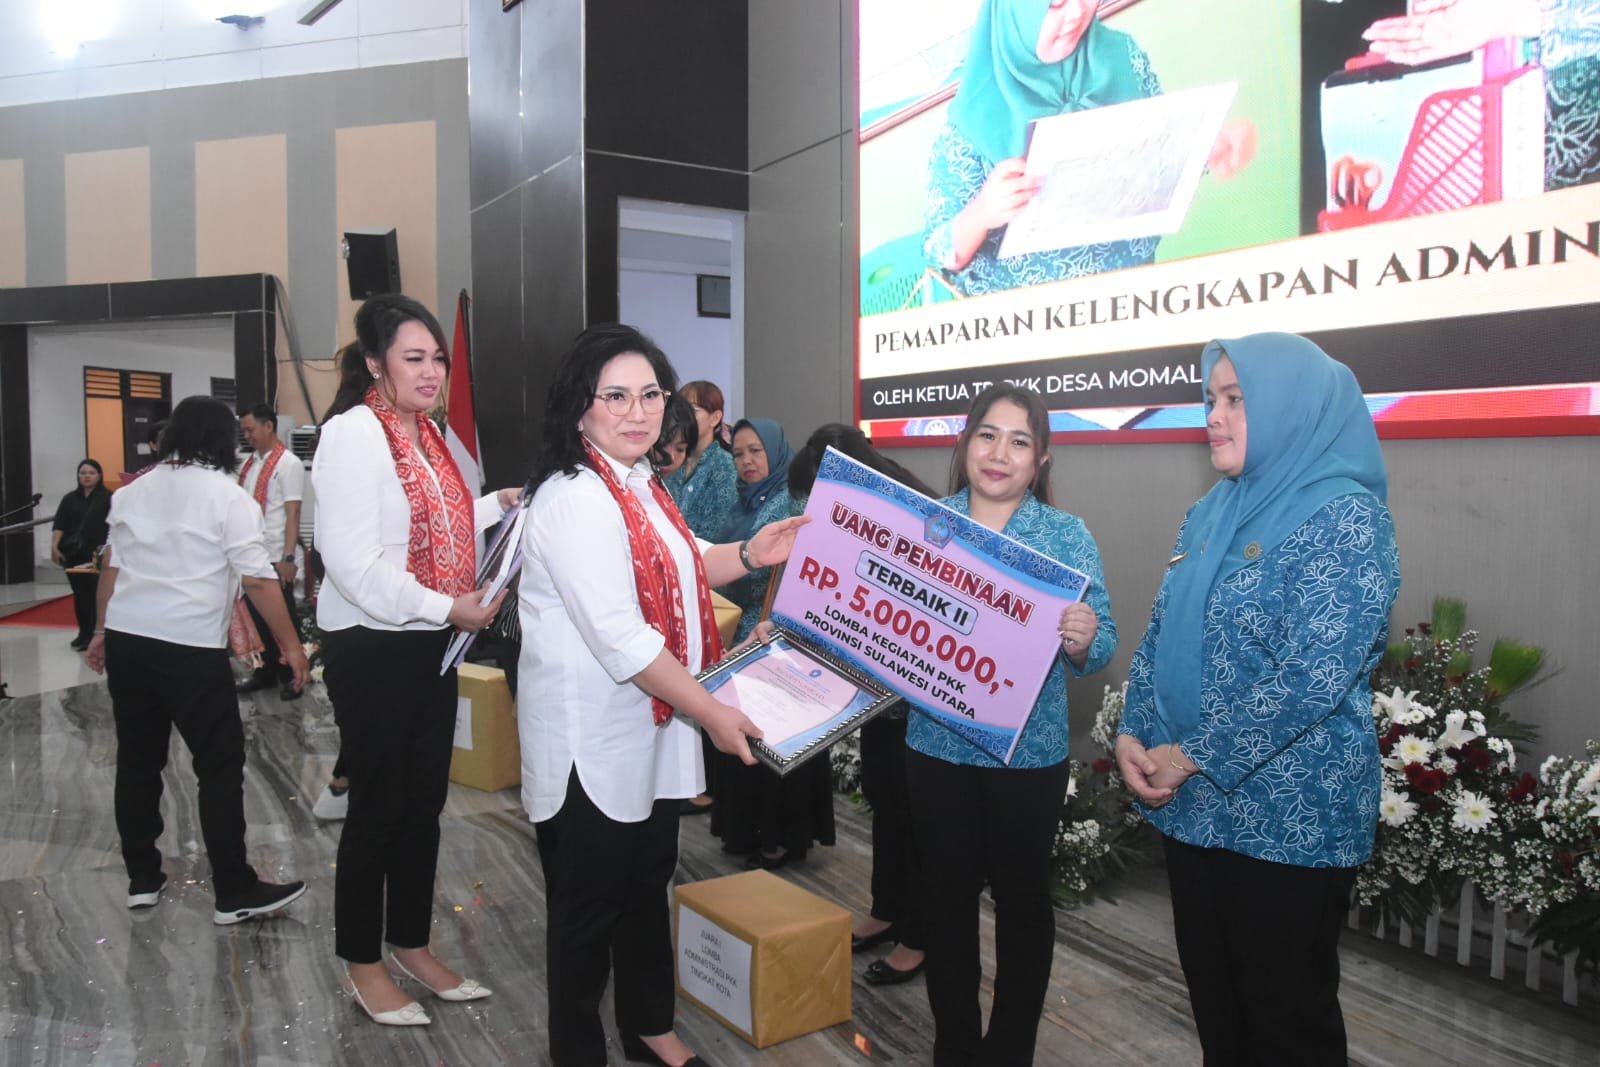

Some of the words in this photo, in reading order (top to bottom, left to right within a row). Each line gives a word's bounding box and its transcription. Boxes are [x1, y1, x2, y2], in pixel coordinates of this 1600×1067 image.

[875, 309, 1034, 353] PEMAPARAN
[1045, 258, 1358, 331] KELENGKAPAN
[873, 387, 912, 405] OLEH
[917, 382, 969, 402] KETUA
[1046, 373, 1101, 393] DESA
[830, 502, 892, 551] UANG
[892, 538, 1034, 626] PEMBINAAN
[867, 559, 951, 617] TERBAIK
[953, 608, 968, 627] II
[799, 556, 842, 600] RP.
[848, 585, 1015, 695] 5.000.000,-
[824, 604, 868, 637] LOMBA
[871, 632, 936, 673] KEGIATAN
[937, 670, 966, 695] PKK
[804, 611, 862, 650] PROVINSI
[863, 646, 928, 692] SULAWESI
[931, 687, 975, 720] UTARA
[684, 948, 724, 979] ADMINISTRASI
[691, 965, 715, 987] TINGKAT
[716, 982, 731, 999] KOTA
[701, 944, 720, 961] LOMBA
